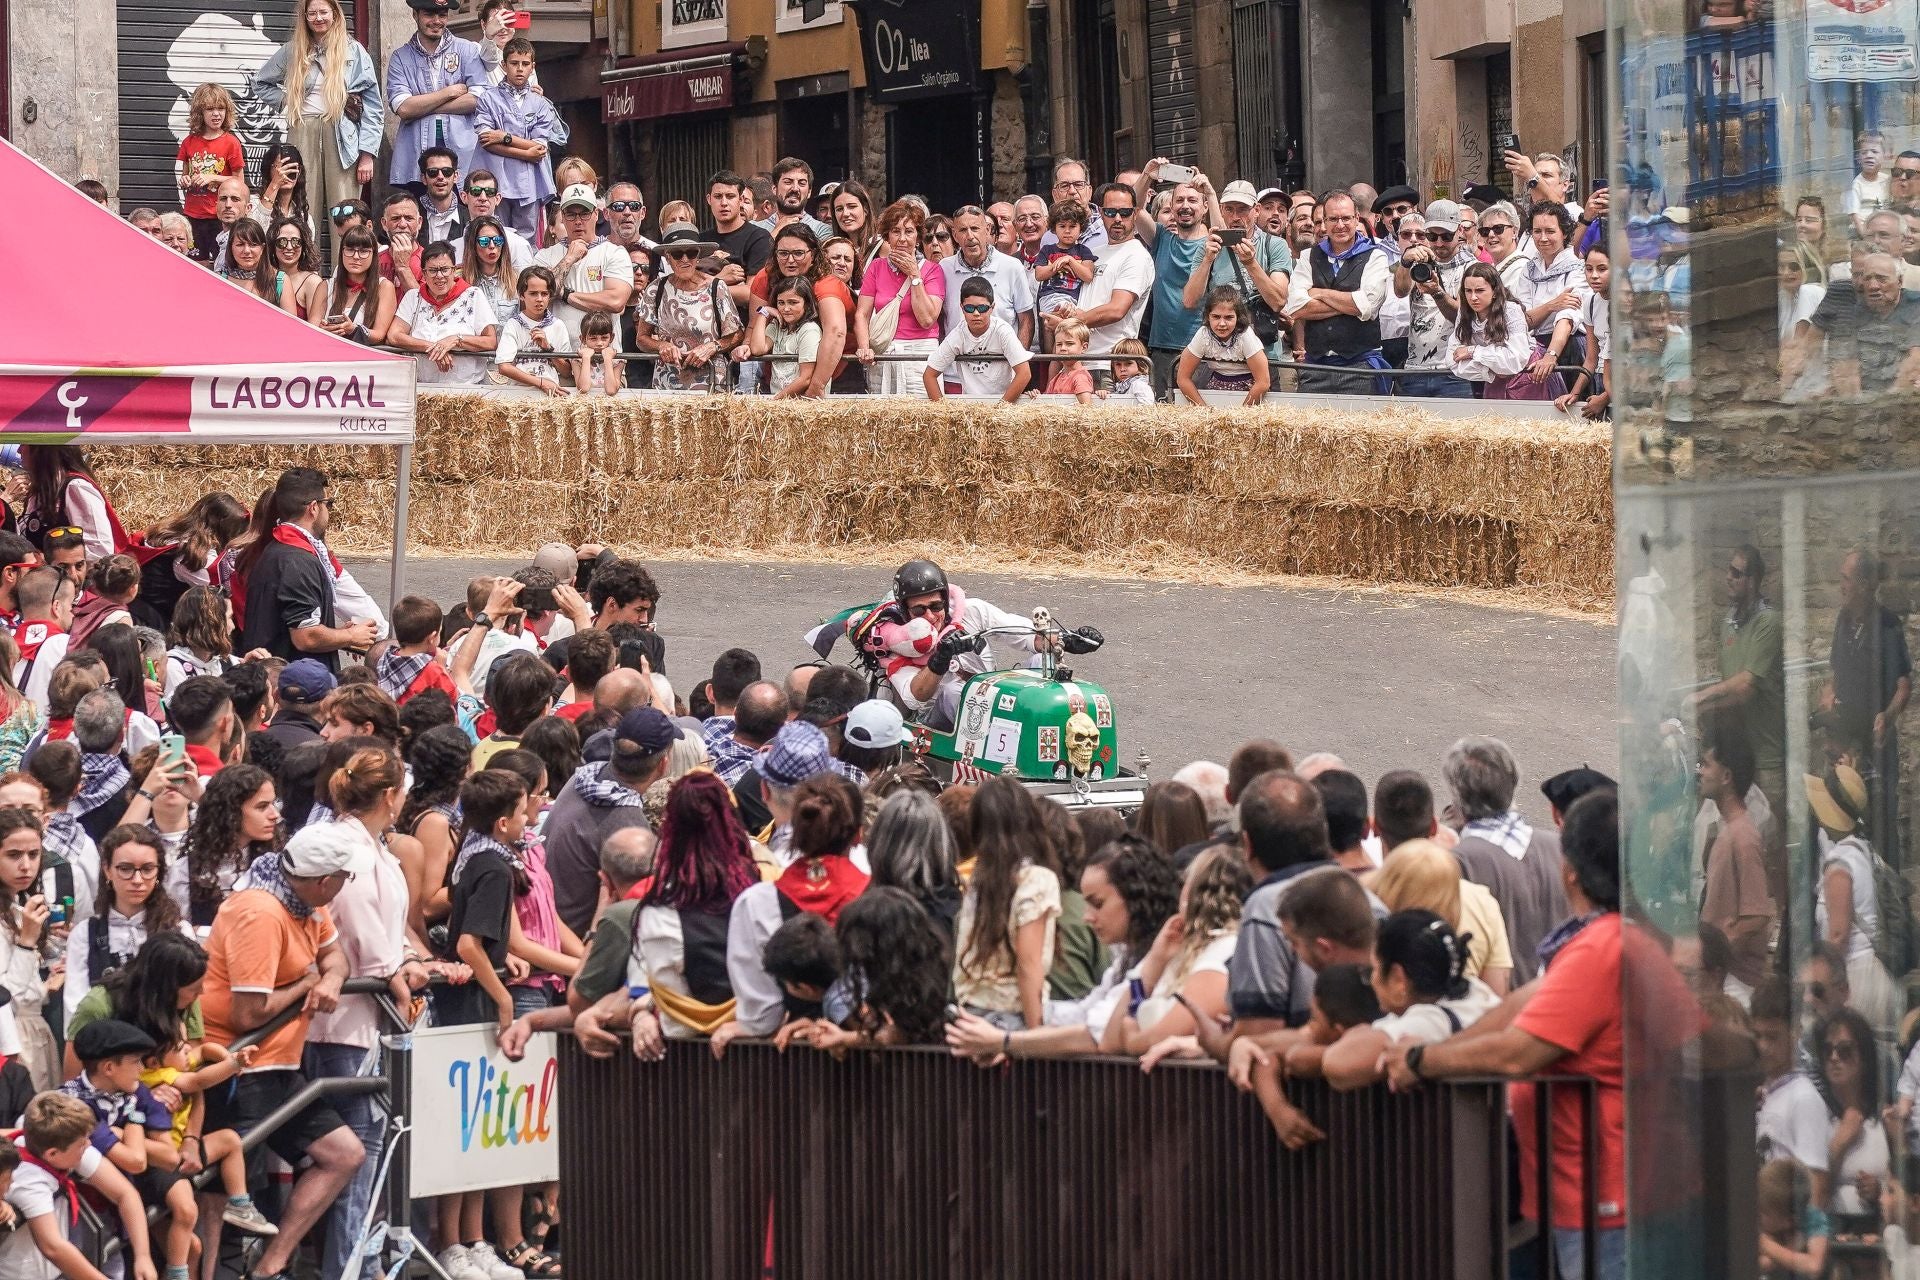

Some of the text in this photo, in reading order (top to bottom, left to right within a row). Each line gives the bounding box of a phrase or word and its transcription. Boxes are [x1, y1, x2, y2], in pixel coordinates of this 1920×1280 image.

[909, 37, 930, 62] ilea
[693, 75, 723, 98] AMBAR
[210, 375, 386, 409] LABORAL
[339, 416, 387, 432] kutxa
[997, 734, 1006, 752] 5
[448, 1056, 558, 1152] Vital
